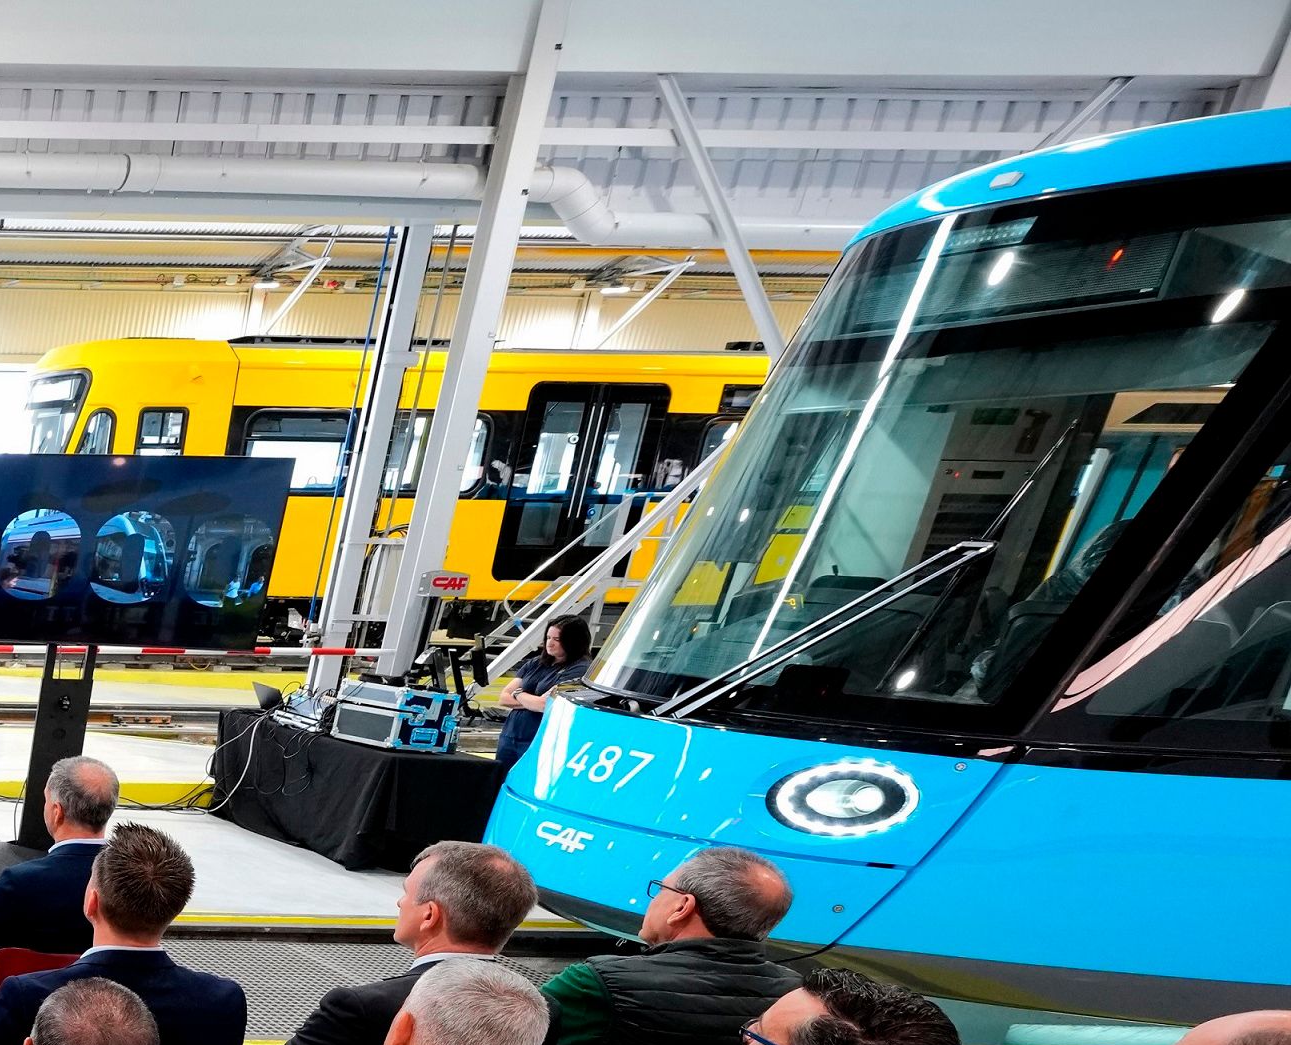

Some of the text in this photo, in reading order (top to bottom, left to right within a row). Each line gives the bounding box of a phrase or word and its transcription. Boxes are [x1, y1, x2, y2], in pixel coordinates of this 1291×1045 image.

[431, 576, 469, 591] CAF
[566, 741, 656, 793] 487
[535, 820, 595, 853] CAF
